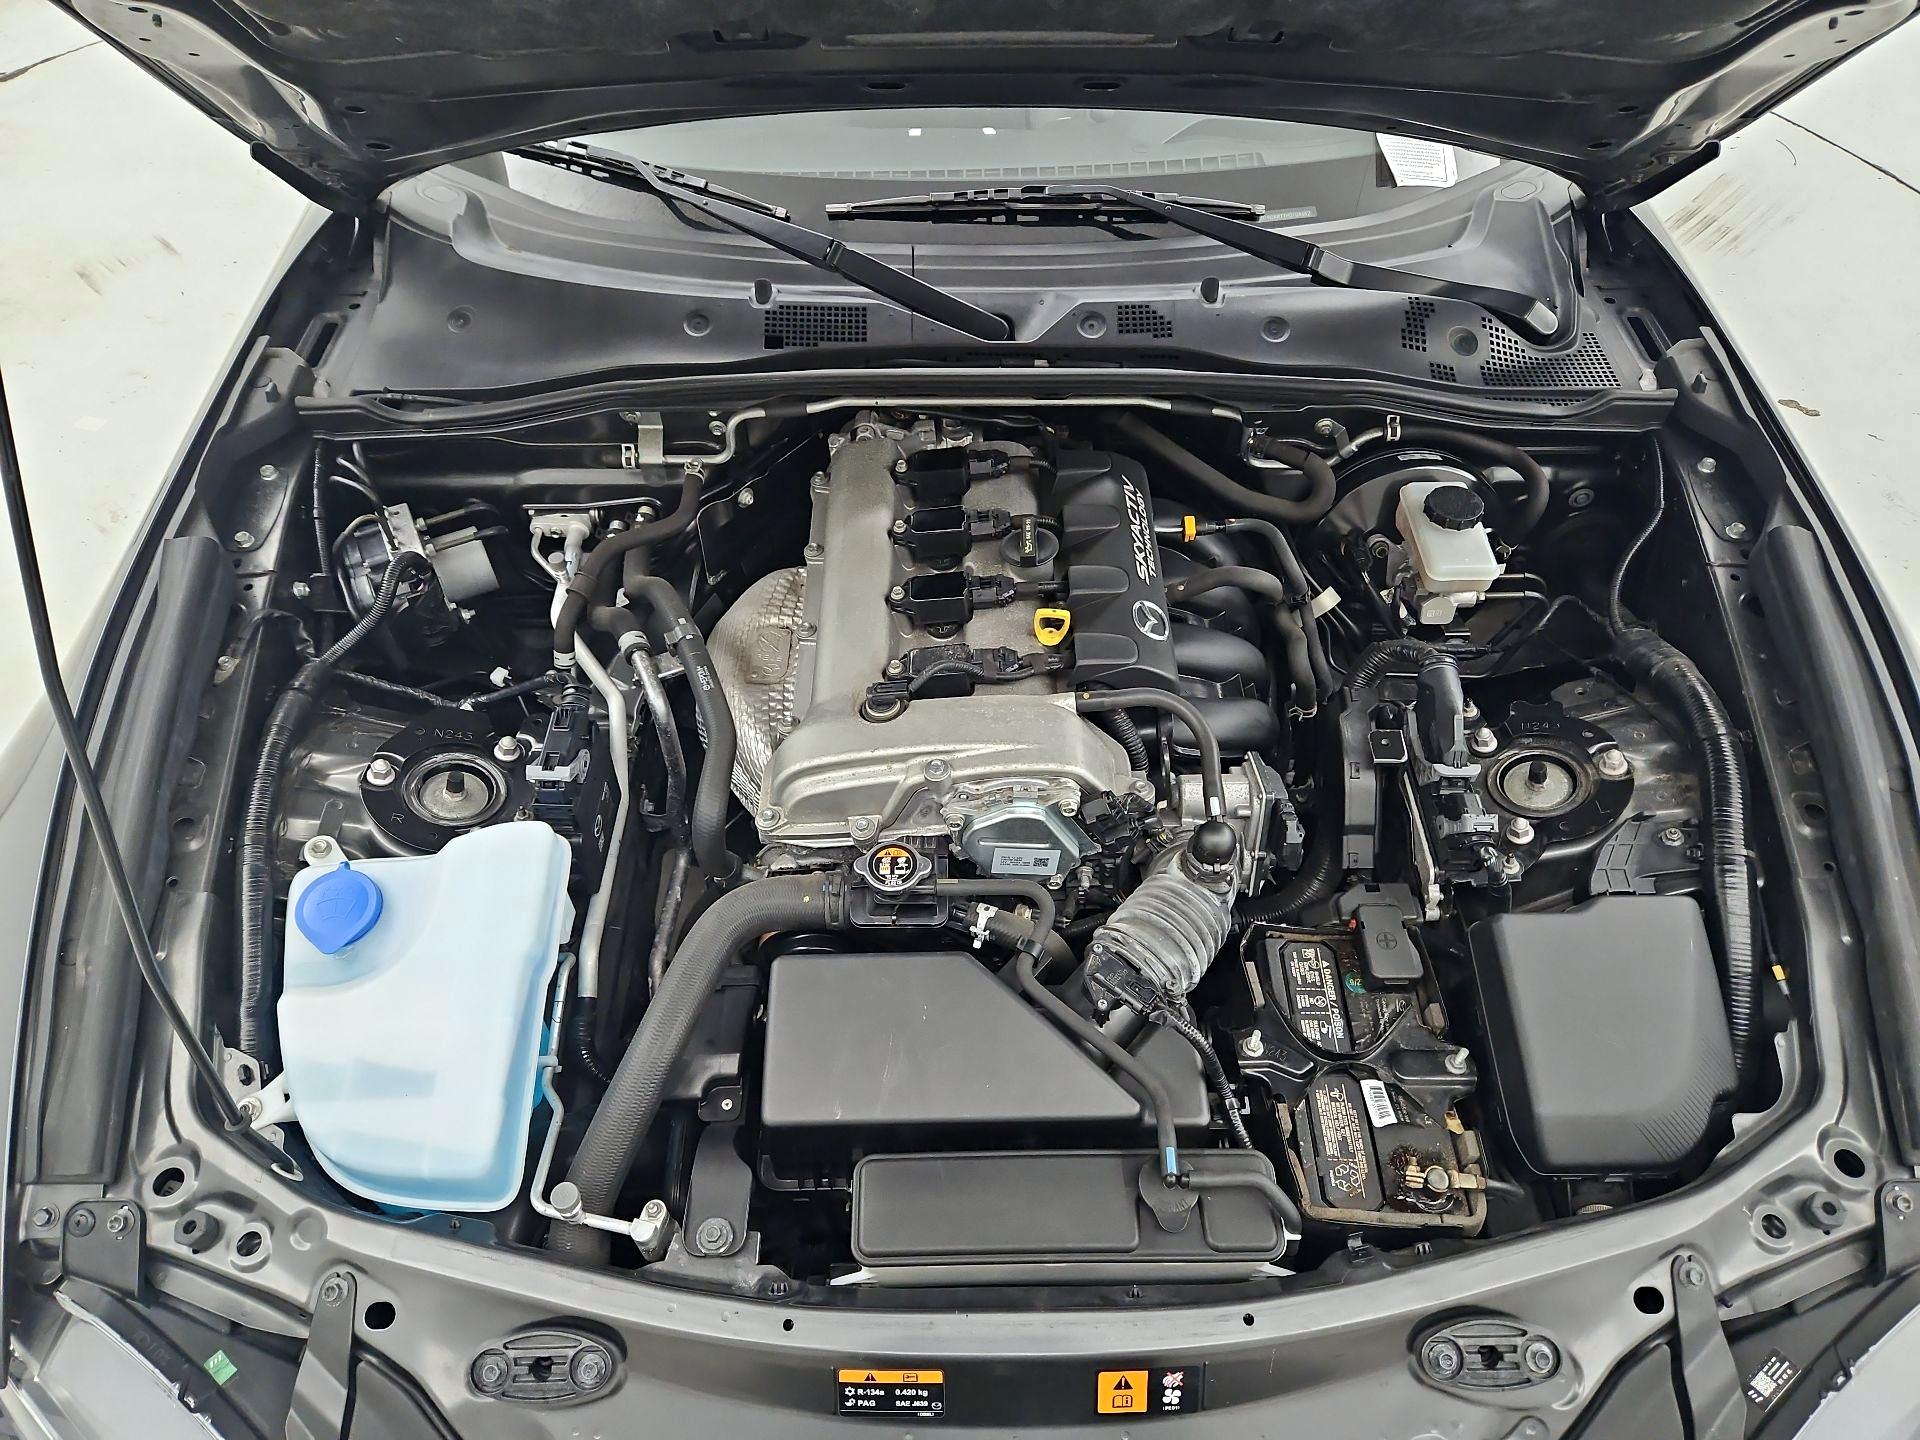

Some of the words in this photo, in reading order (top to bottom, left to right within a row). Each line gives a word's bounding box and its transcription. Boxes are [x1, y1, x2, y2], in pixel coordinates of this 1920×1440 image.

[1121, 474, 1150, 585] SKYACTIV
[1135, 488, 1156, 578] TECHNOLOGY
[1323, 968, 1337, 1001] DANGER
[1331, 1007, 1344, 1039] POISON
[918, 1389, 928, 1397] kg
